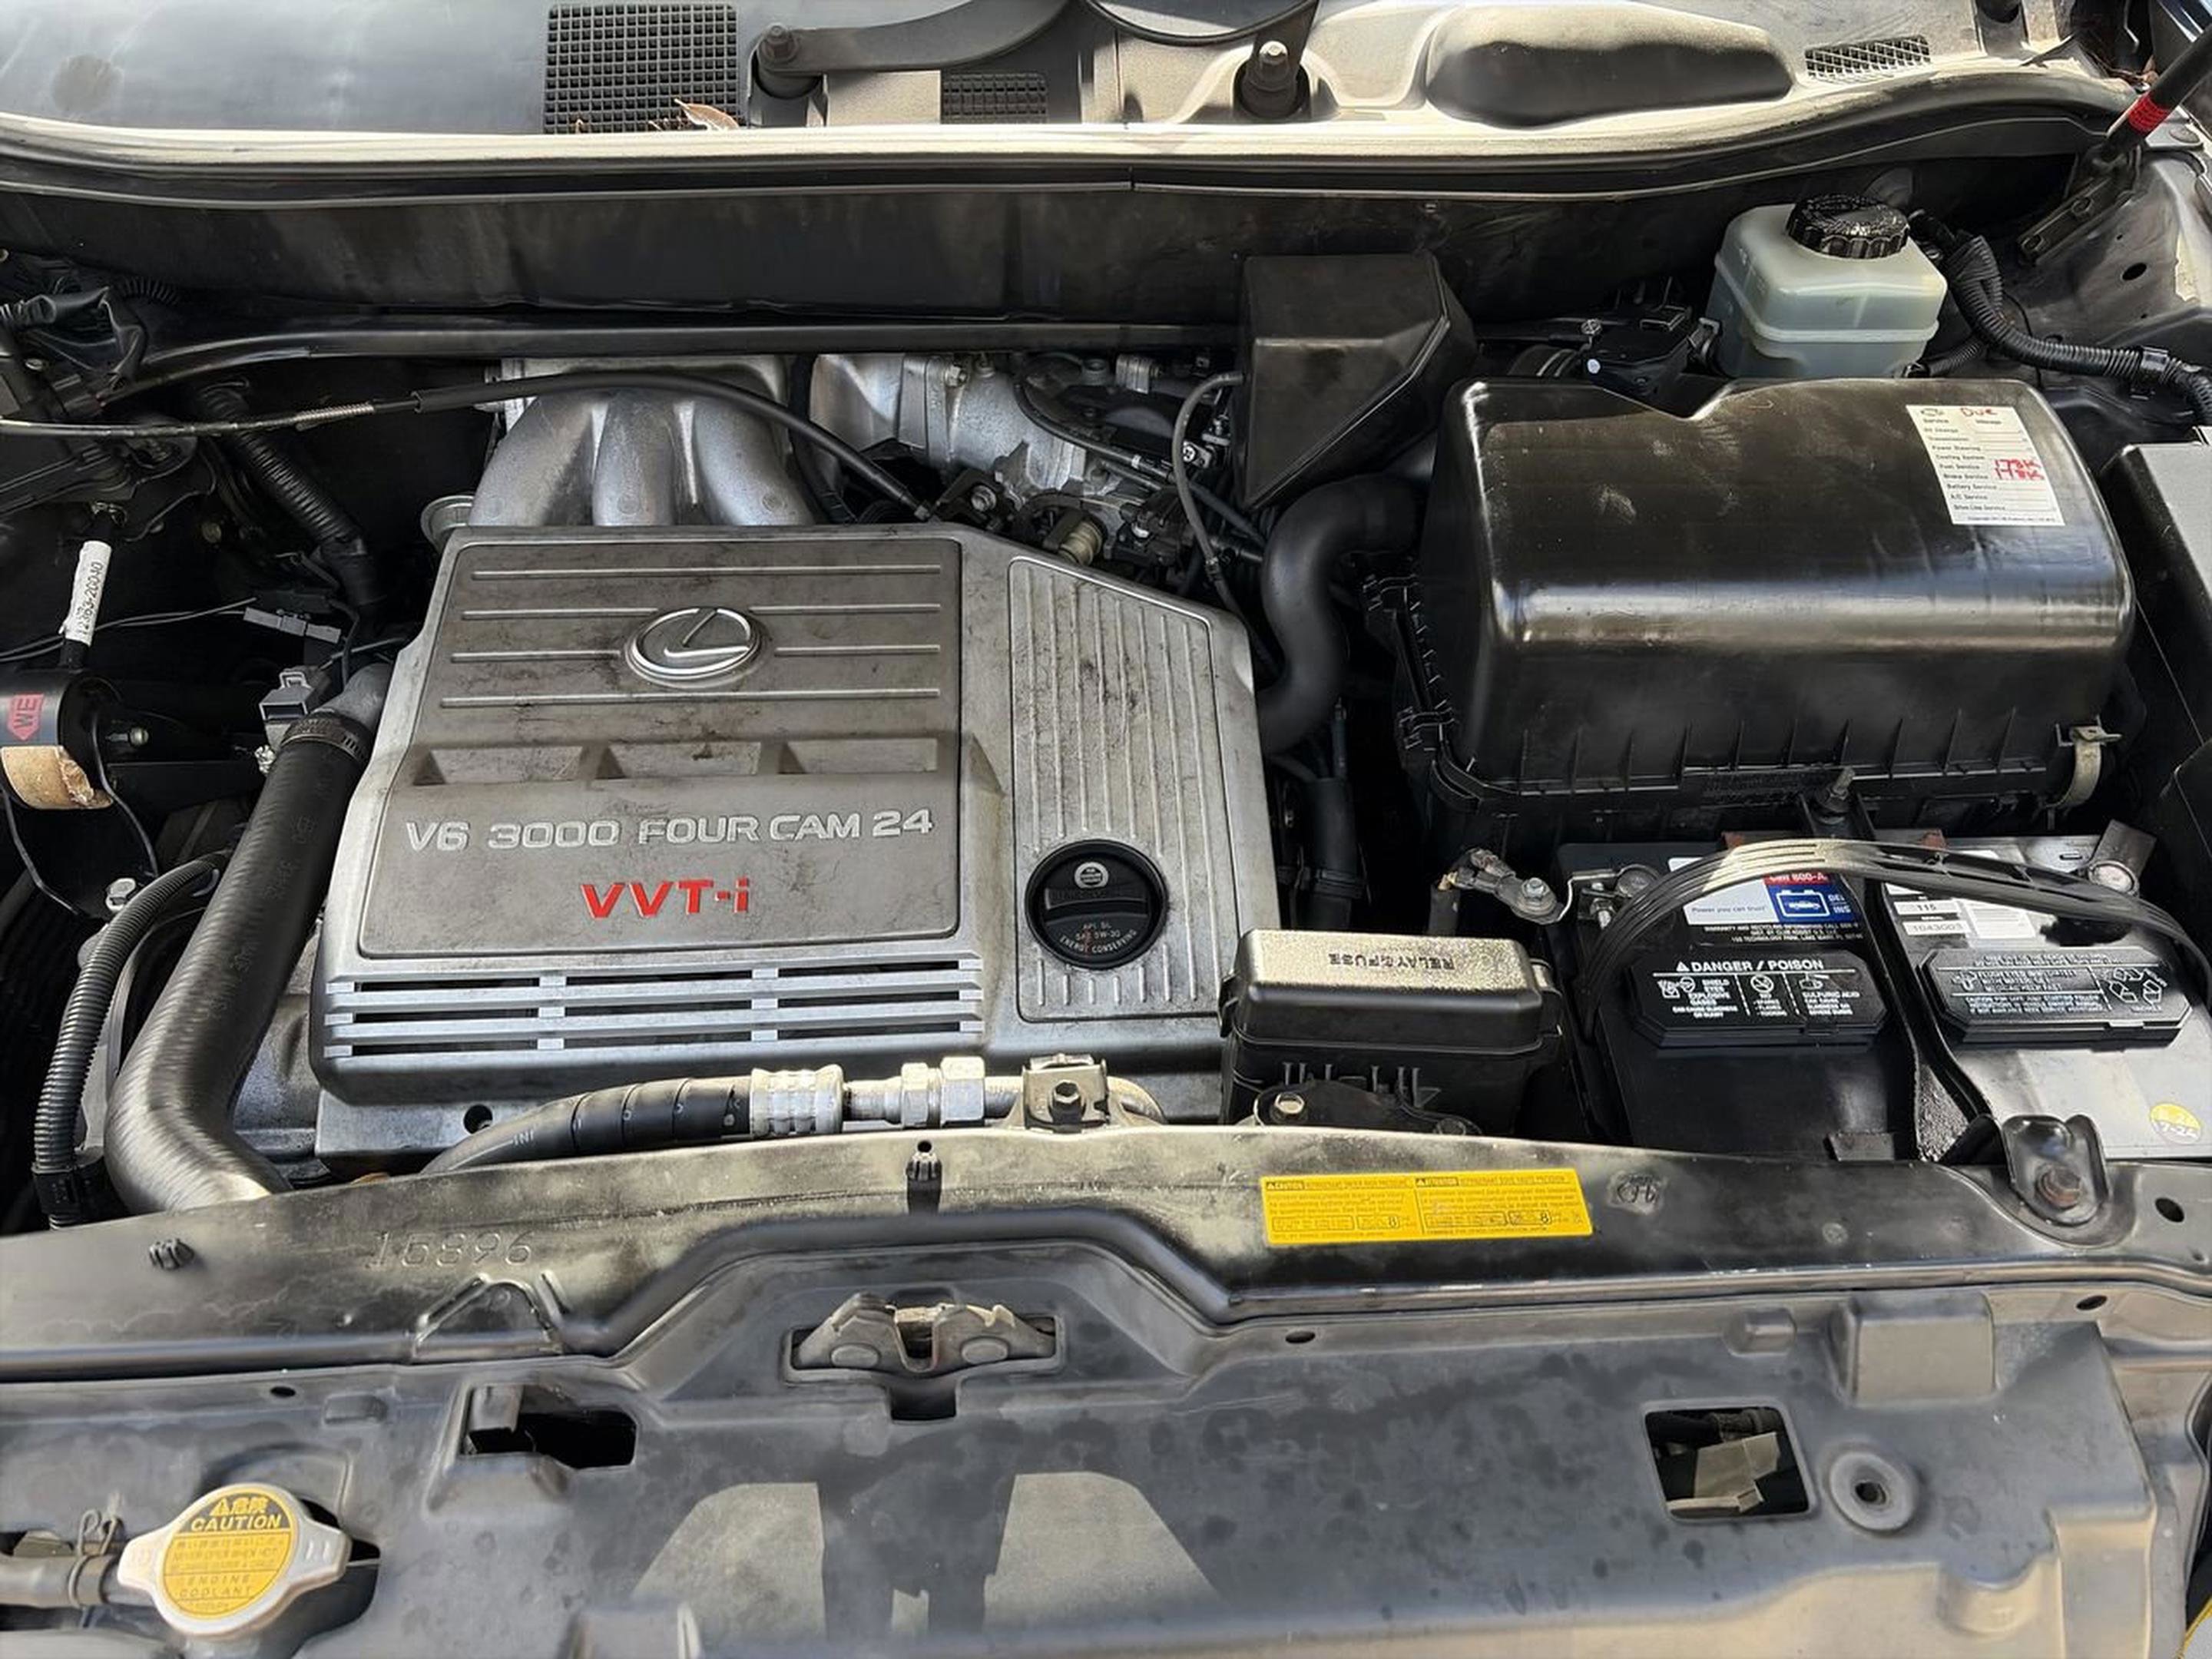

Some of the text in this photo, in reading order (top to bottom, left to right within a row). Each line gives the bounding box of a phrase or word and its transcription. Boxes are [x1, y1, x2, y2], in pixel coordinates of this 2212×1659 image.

[405, 808, 933, 851] V6 3000 FOUR CAM 24
[581, 877, 750, 919] VVT-i
[1690, 960, 1753, 972] DANGER
[1767, 959, 1824, 971] POISON
[190, 1515, 283, 1532] CAUTION
